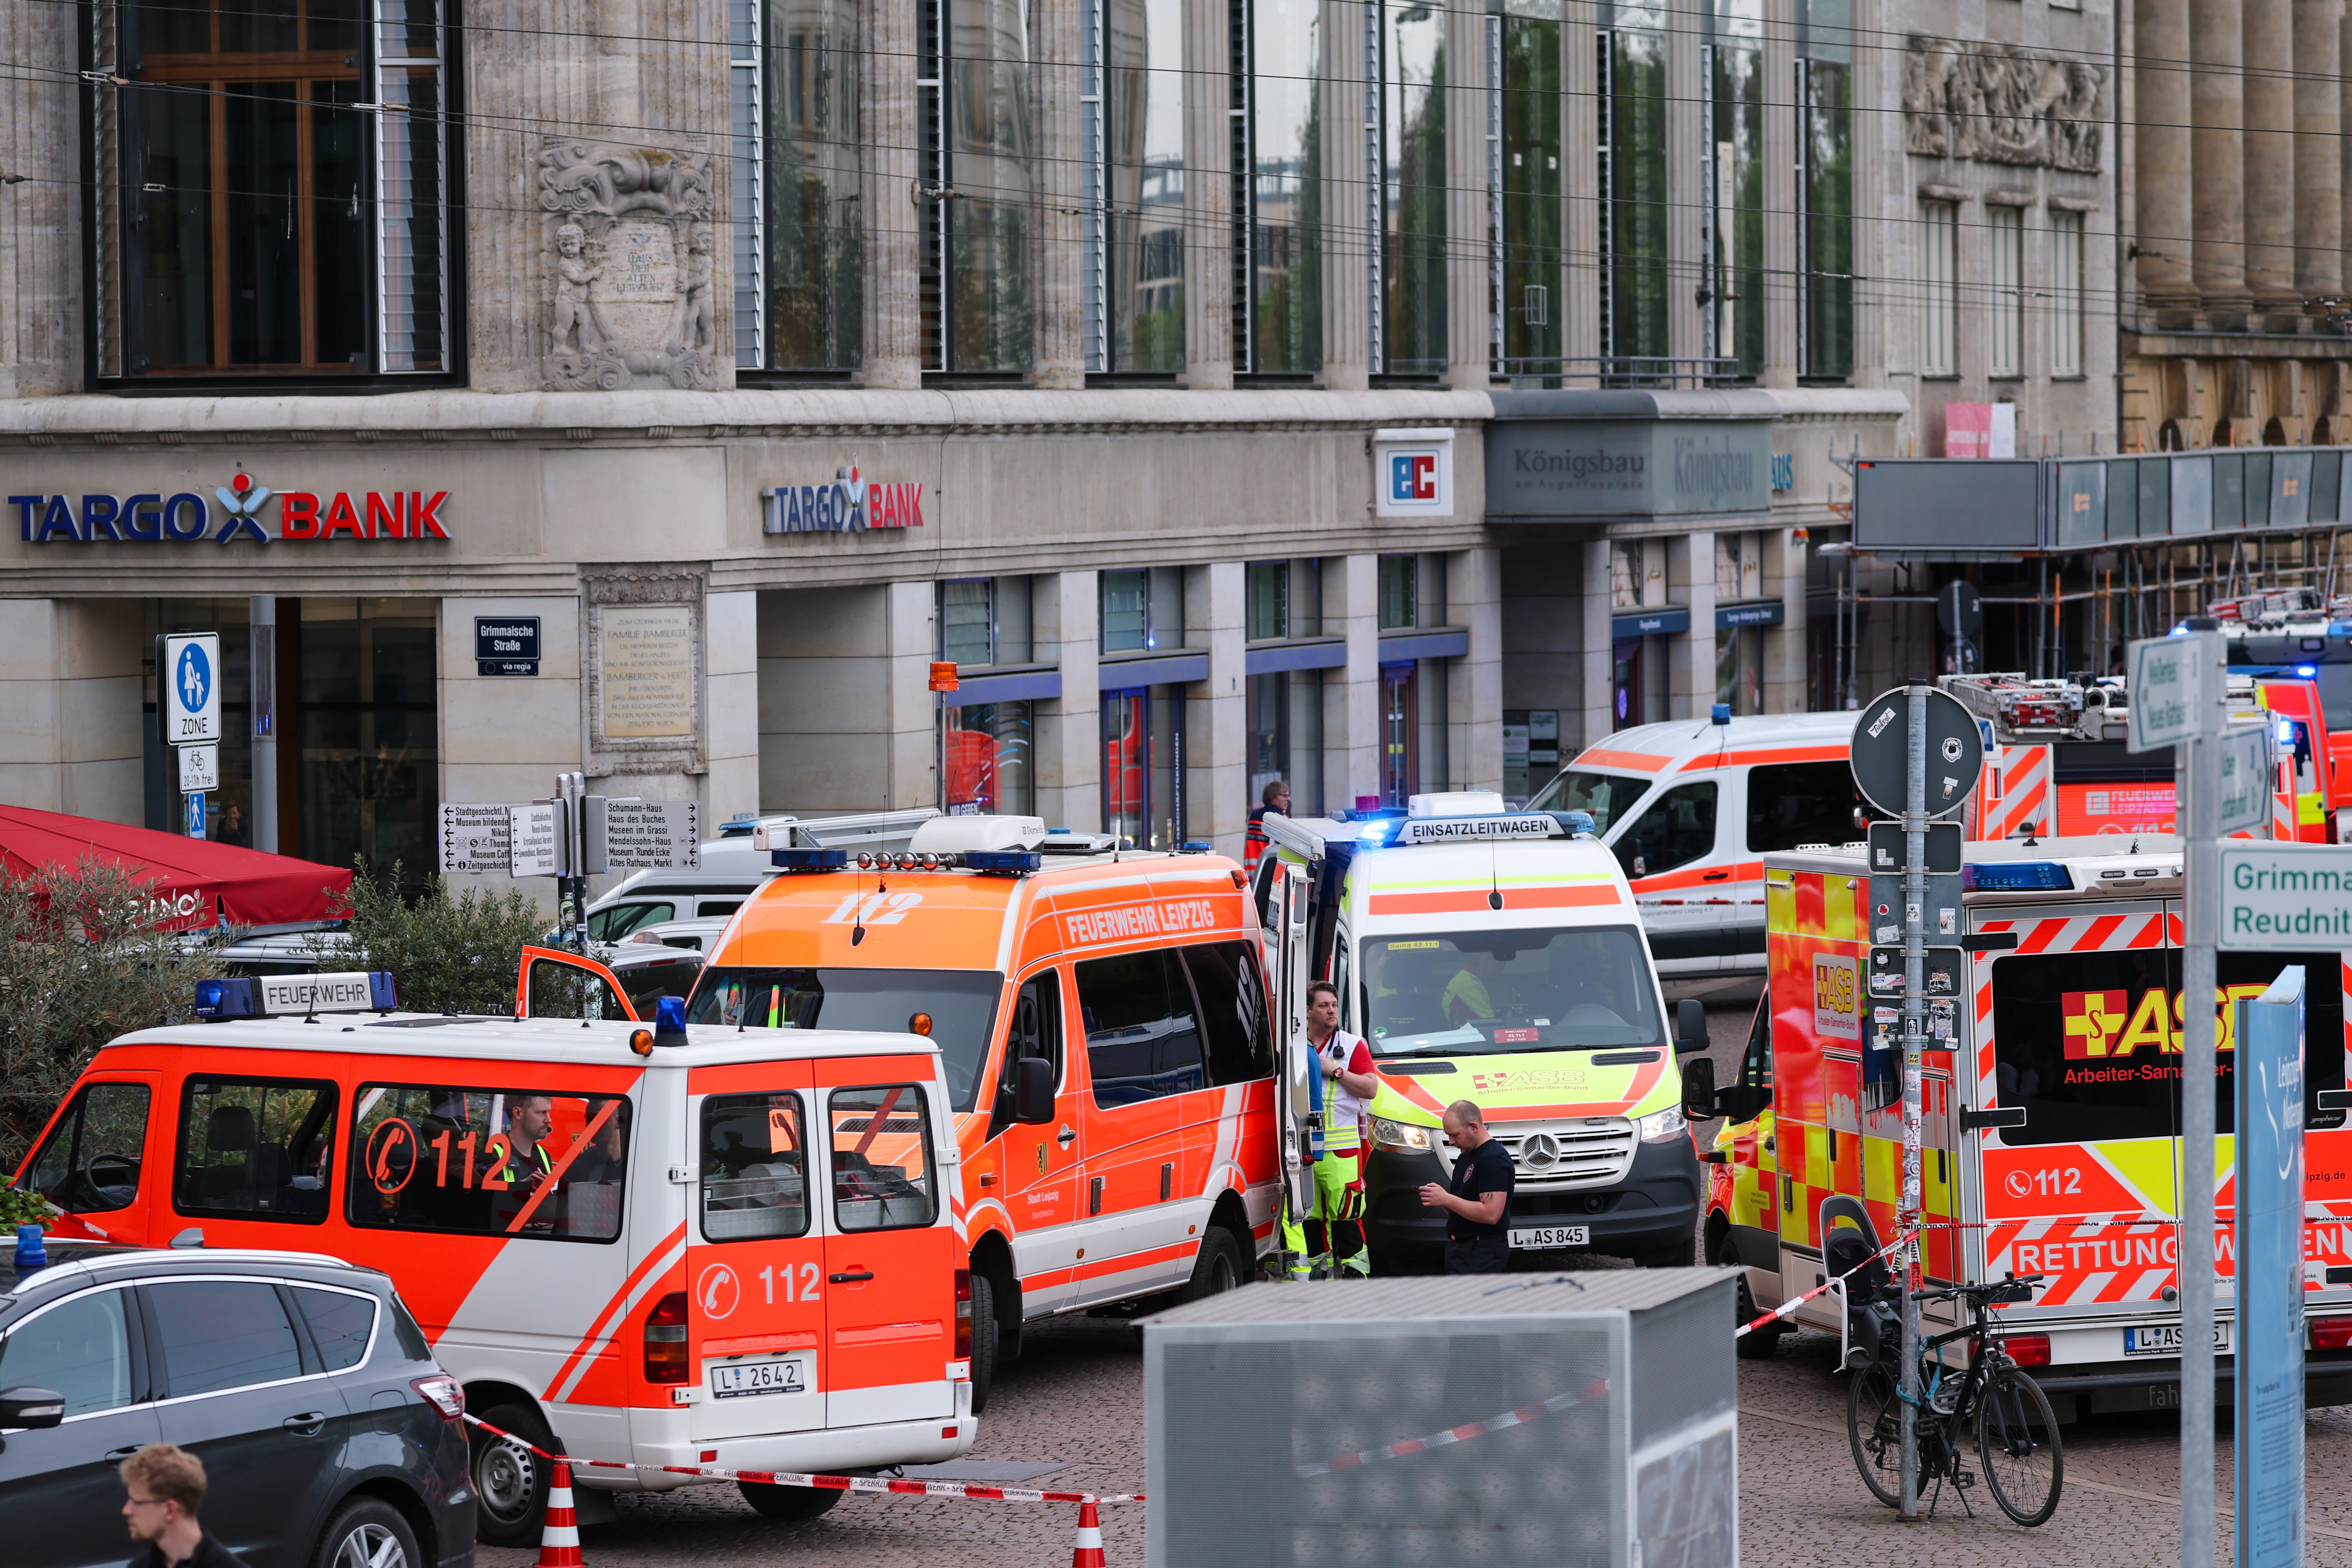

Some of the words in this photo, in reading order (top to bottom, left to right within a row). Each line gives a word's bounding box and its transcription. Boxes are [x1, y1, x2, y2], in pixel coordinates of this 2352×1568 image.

[628, 255, 653, 263] HAUS
[626, 274, 655, 282] ALTEN
[1514, 448, 1644, 479] Königsbau
[774, 484, 845, 533] TARGO
[869, 483, 924, 528] BANK
[8, 493, 210, 541] TARGO
[281, 491, 452, 539] BANK
[480, 625, 533, 637] Grimmaische
[644, 629, 687, 638] BAMBERGER
[494, 640, 520, 651] Straße
[514, 662, 531, 671] regia
[607, 672, 658, 681] BAMBERGER
[182, 717, 207, 734] ZONE
[202, 773, 213, 785] frei
[456, 807, 504, 817] Stadtgeschichtl.
[608, 803, 662, 812] Schumann-Haus
[950, 805, 960, 817] WIR
[961, 803, 978, 816] GEBEN
[2112, 804, 2156, 815] LEIPZIG
[456, 818, 481, 826] Museum
[608, 814, 624, 823] Haus
[628, 814, 639, 823] des
[642, 815, 665, 823] Buches
[532, 825, 540, 833] Neues
[541, 824, 552, 832] Rathaus
[609, 825, 633, 834] Museen
[637, 826, 644, 834] im
[648, 826, 667, 834] Grassi
[1027, 825, 1043, 835] Dometic
[1412, 820, 1548, 838] EINSATZLEITWAGEN
[609, 836, 671, 845] Mendelssohn-Haus
[471, 850, 495, 858] Museum
[609, 848, 633, 856] Museum
[609, 858, 625, 867] Altes
[627, 858, 652, 868] Rathaus,
[655, 858, 672, 867] Markt
[2234, 862, 2352, 890] Grimma
[822, 893, 923, 924] 112
[1067, 906, 1158, 943] FEUERWEHR
[1158, 900, 1215, 931] LEIPZIG
[2234, 906, 2350, 934] Reudnit
[269, 983, 365, 1005] FEUERWEHR
[1826, 966, 1854, 1014] ASB
[1251, 991, 1261, 1060] NOTRUF
[1818, 1015, 1855, 1030] Arbeiter-Samariter-Bund
[1501, 1070, 1585, 1086] ASB
[1477, 1085, 1588, 1095] Arbeiter-Samariter-Bund
[2311, 1115, 2341, 1123] graphicar
[431, 1130, 511, 1191] 112
[2035, 1167, 2081, 1196] 112
[1028, 1192, 1040, 1205] Stadt
[1042, 1189, 1059, 1203] Leipzig
[1032, 1208, 1054, 1219] Branddirektion
[1514, 1231, 1523, 1245] L
[1534, 1230, 1552, 1244] AS
[1556, 1228, 1583, 1243] 845
[760, 1262, 820, 1304] 112
[716, 1336, 804, 1351] MERCEDES-BENZ
[2141, 1330, 2151, 1346] L
[2164, 1328, 2183, 1345] AS
[722, 1371, 731, 1389] L
[750, 1365, 795, 1387] 2642
[724, 1469, 761, 1479] FEUERWEHR
[768, 1472, 805, 1483] SPERRZONE
[815, 1475, 854, 1486] FEUERWEHR
[859, 1478, 897, 1490] SPERRZONE
[907, 1482, 946, 1492] FEUERWEHR
